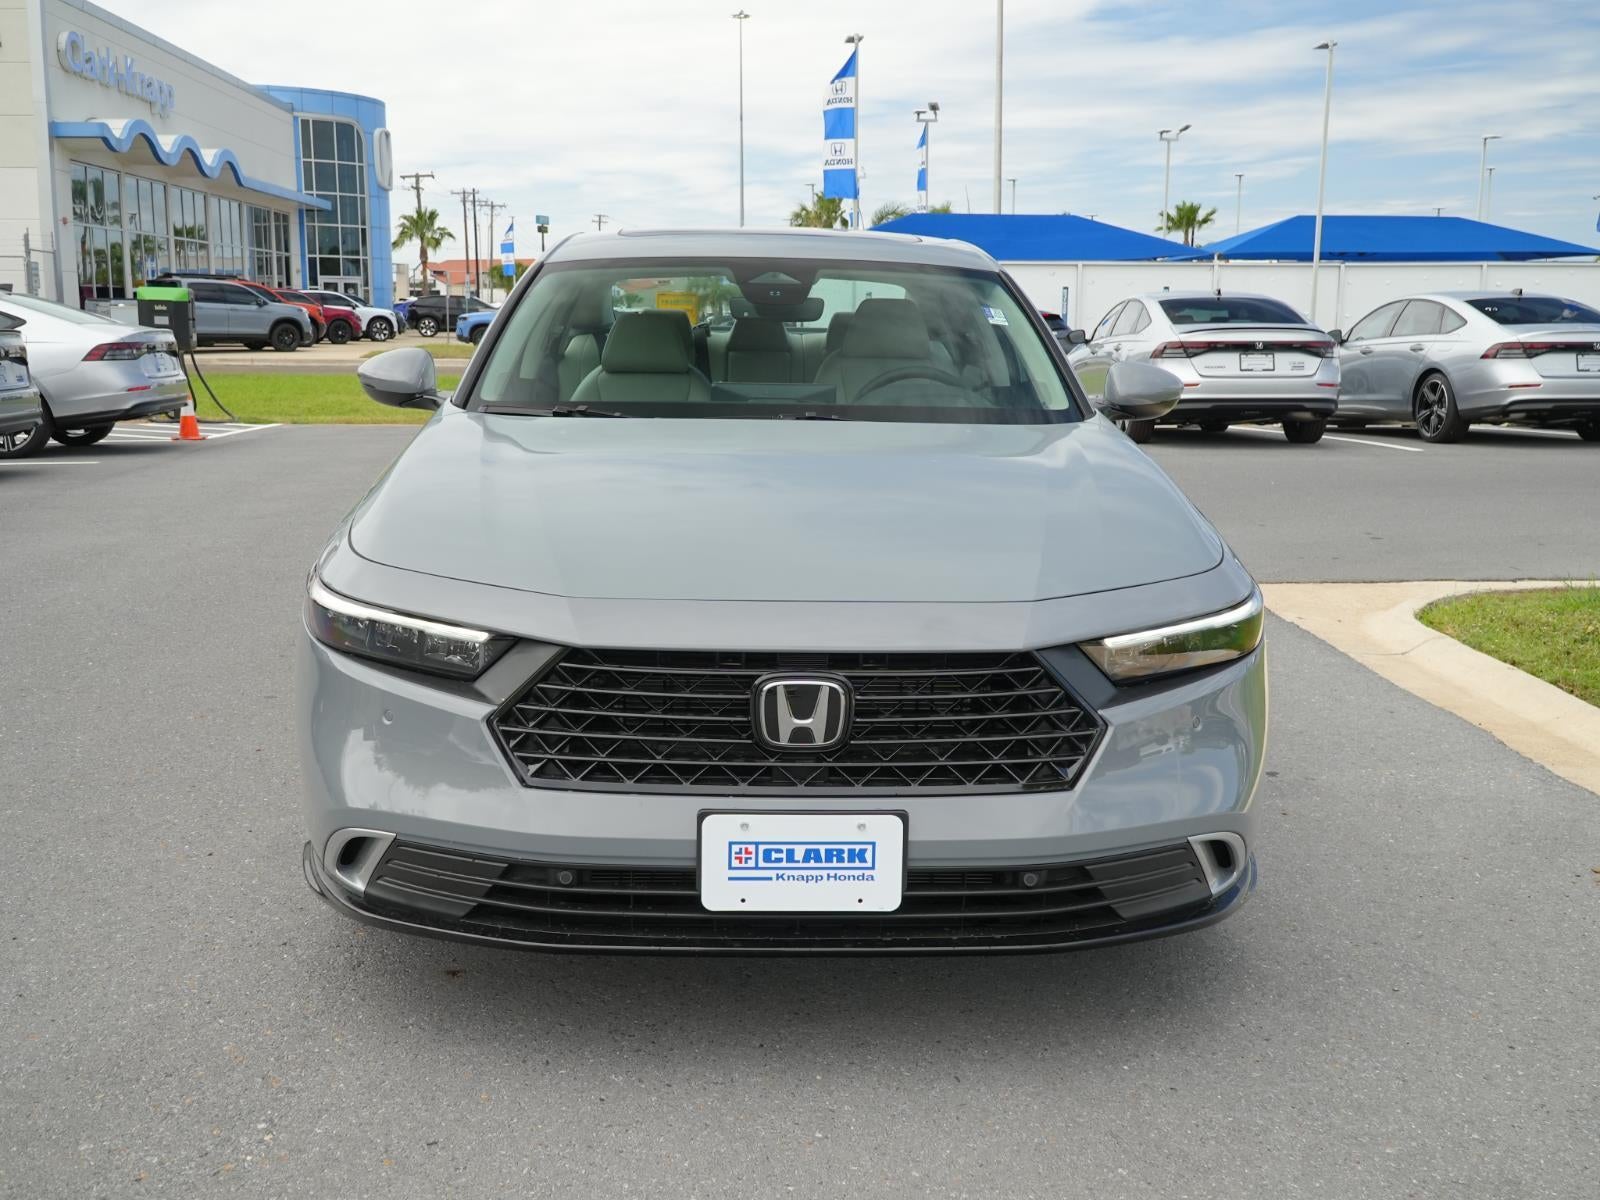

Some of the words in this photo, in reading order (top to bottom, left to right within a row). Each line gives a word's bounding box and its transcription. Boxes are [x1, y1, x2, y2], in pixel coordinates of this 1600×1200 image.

[58, 31, 176, 117] Clark-Knapp
[762, 847, 868, 864] CLARK
[775, 872, 824, 883] Knapp
[826, 872, 875, 882] Honda
